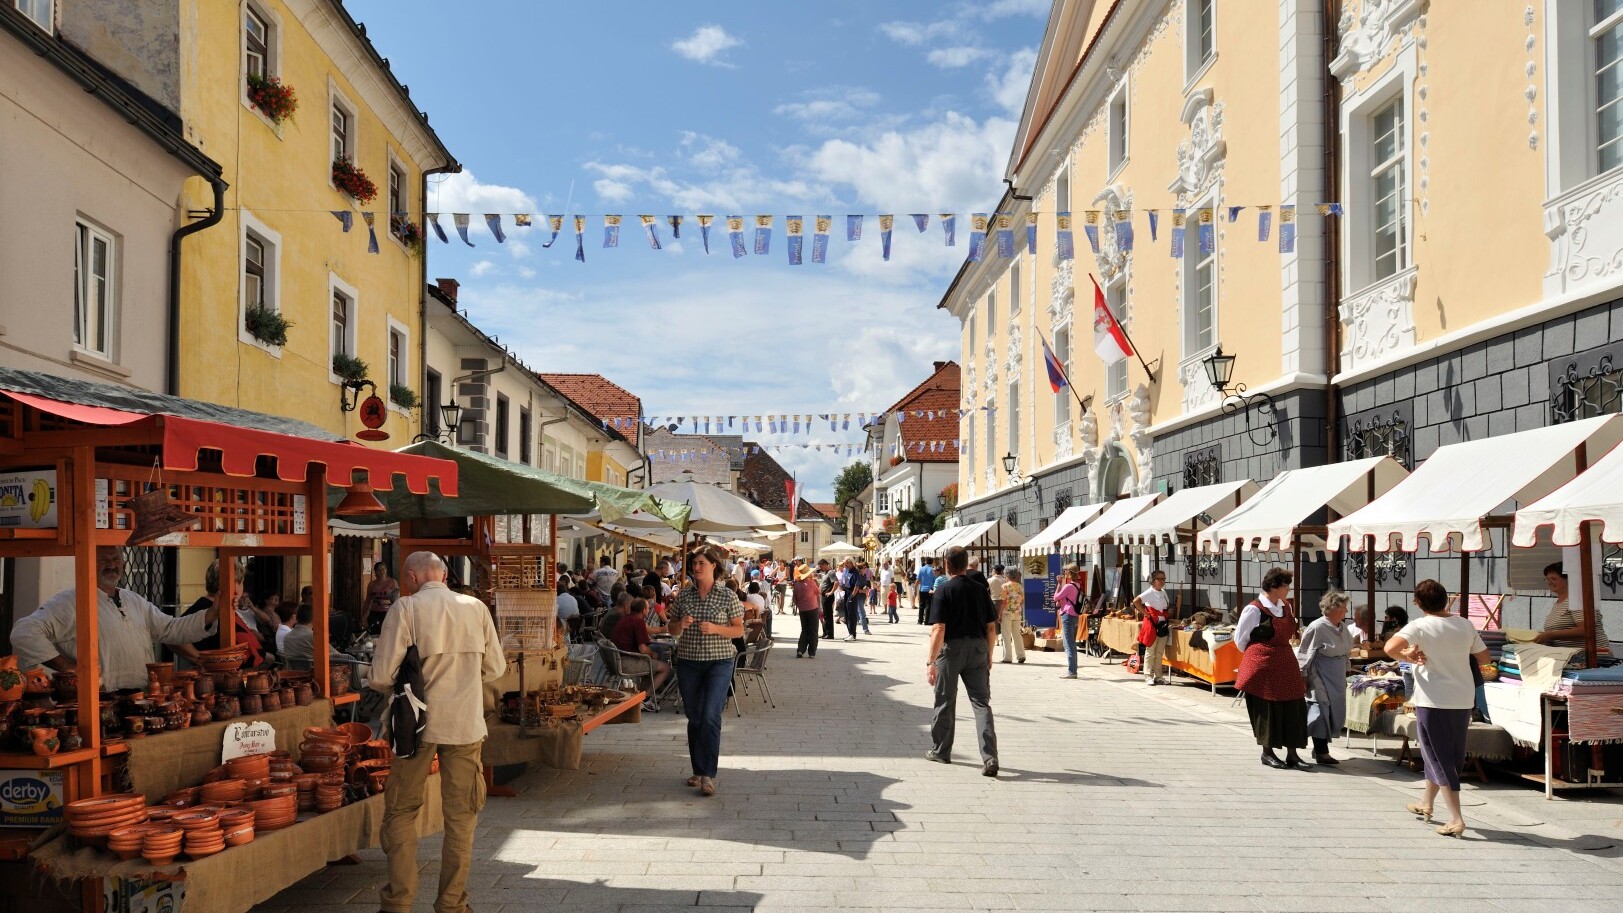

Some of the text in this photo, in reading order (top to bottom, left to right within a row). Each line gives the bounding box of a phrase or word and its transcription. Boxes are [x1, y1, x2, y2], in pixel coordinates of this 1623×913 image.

[1042, 580, 1051, 610] Festival
[2, 778, 46, 803] derby
[4, 816, 39, 824] PREMIUM
